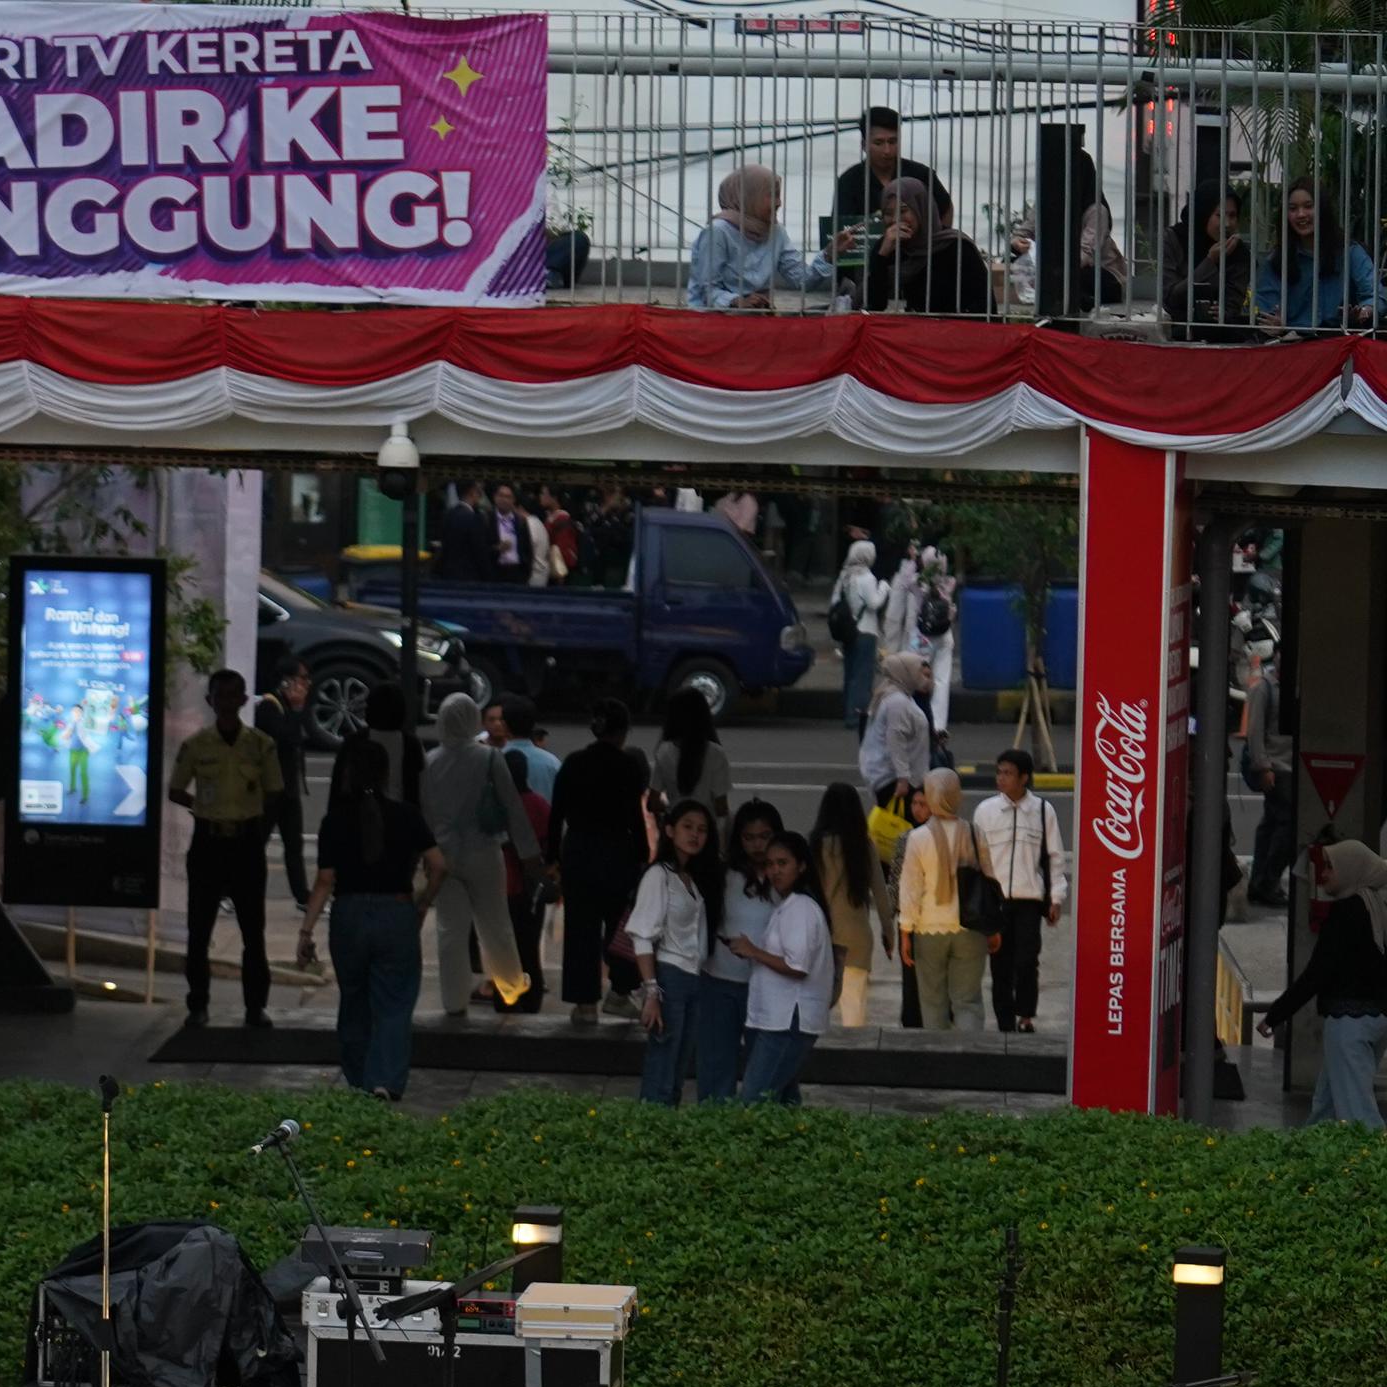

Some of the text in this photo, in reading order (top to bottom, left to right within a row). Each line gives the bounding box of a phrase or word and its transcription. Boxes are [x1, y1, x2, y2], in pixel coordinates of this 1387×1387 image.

[55, 34, 130, 79] TV
[146, 30, 373, 76] KERETA
[261, 84, 405, 165] KE
[1093, 691, 1148, 860] Coca-Cola
[1107, 868, 1127, 1037] LEPAS BERSAMA
